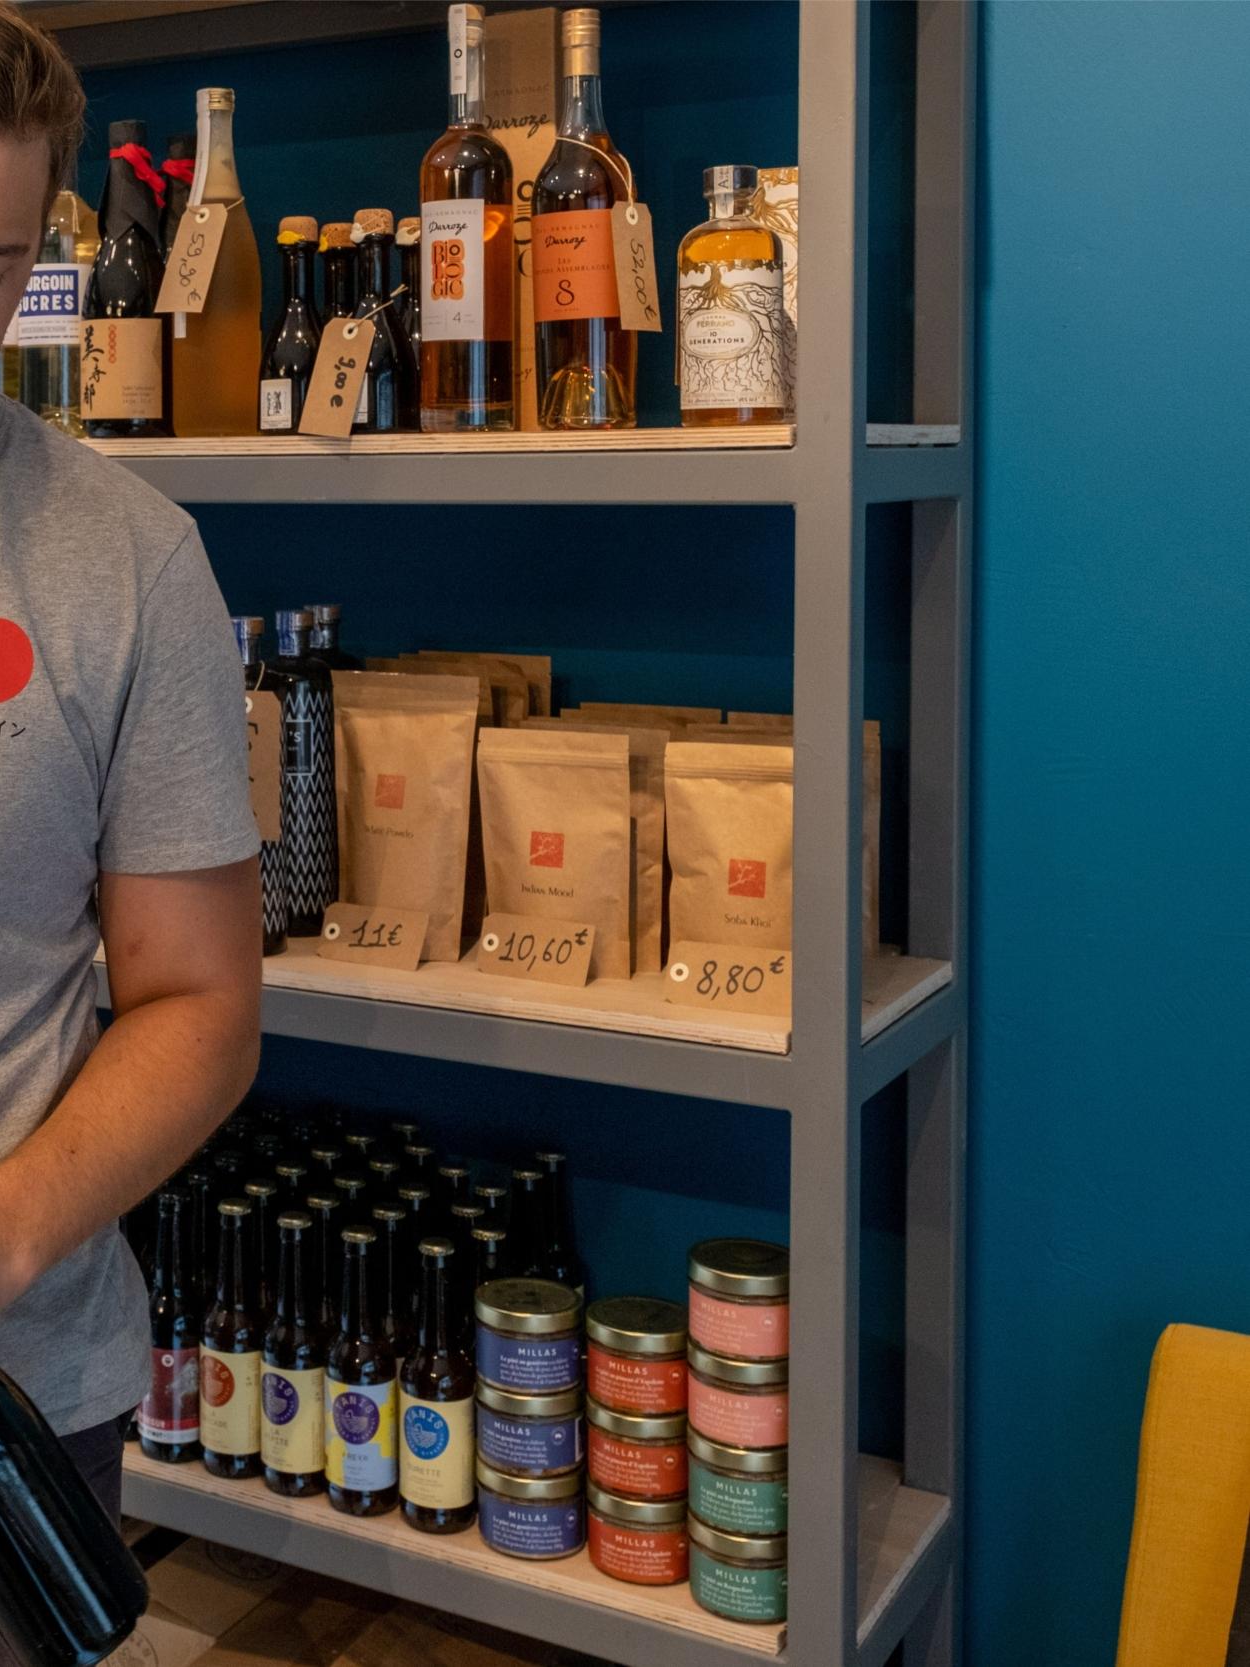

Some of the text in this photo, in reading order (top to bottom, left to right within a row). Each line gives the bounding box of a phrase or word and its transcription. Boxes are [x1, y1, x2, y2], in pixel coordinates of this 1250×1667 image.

[428, 219, 469, 236] Darroze
[544, 234, 588, 250] Darroze
[555, 279, 575, 306] 8
[452, 311, 462, 323] 4
[548, 886, 575, 897] Mood
[349, 920, 403, 947] 11€
[517, 1347, 557, 1357] MILLAS
[608, 1361, 648, 1375] MILLAS
[493, 1421, 531, 1436] MILLAS
[603, 1443, 641, 1459] MILLAS
[715, 1481, 758, 1497] MILLAS
[508, 1511, 548, 1522] MILLAS
[615, 1535, 655, 1549] MILLAS
[715, 1568, 757, 1585] MILLAS
